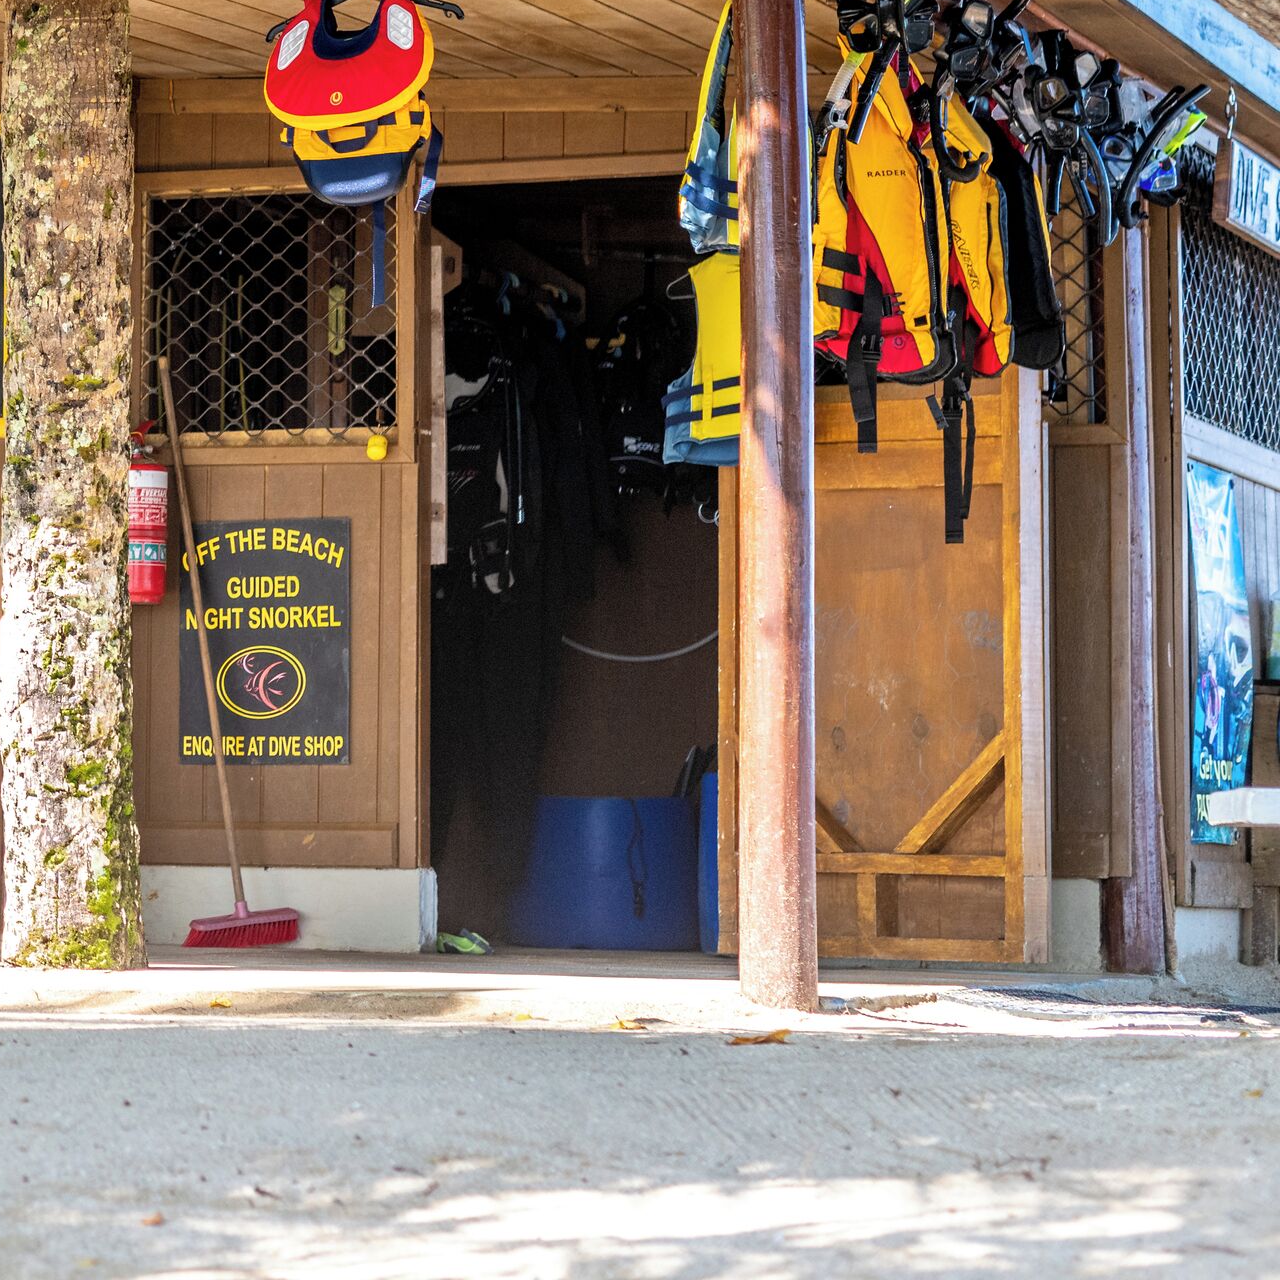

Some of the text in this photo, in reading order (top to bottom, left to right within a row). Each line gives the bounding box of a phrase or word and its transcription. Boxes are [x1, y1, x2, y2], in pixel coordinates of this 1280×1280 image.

[867, 169, 906, 178] RAIDER
[1235, 149, 1270, 234] DIVE
[225, 528, 266, 554] THE
[272, 528, 345, 569] BEACH
[226, 575, 300, 599] GUIDED
[185, 605, 342, 630] NGHT SNORKEL
[183, 735, 344, 757] ENQIRE AT DIVE SHOP
